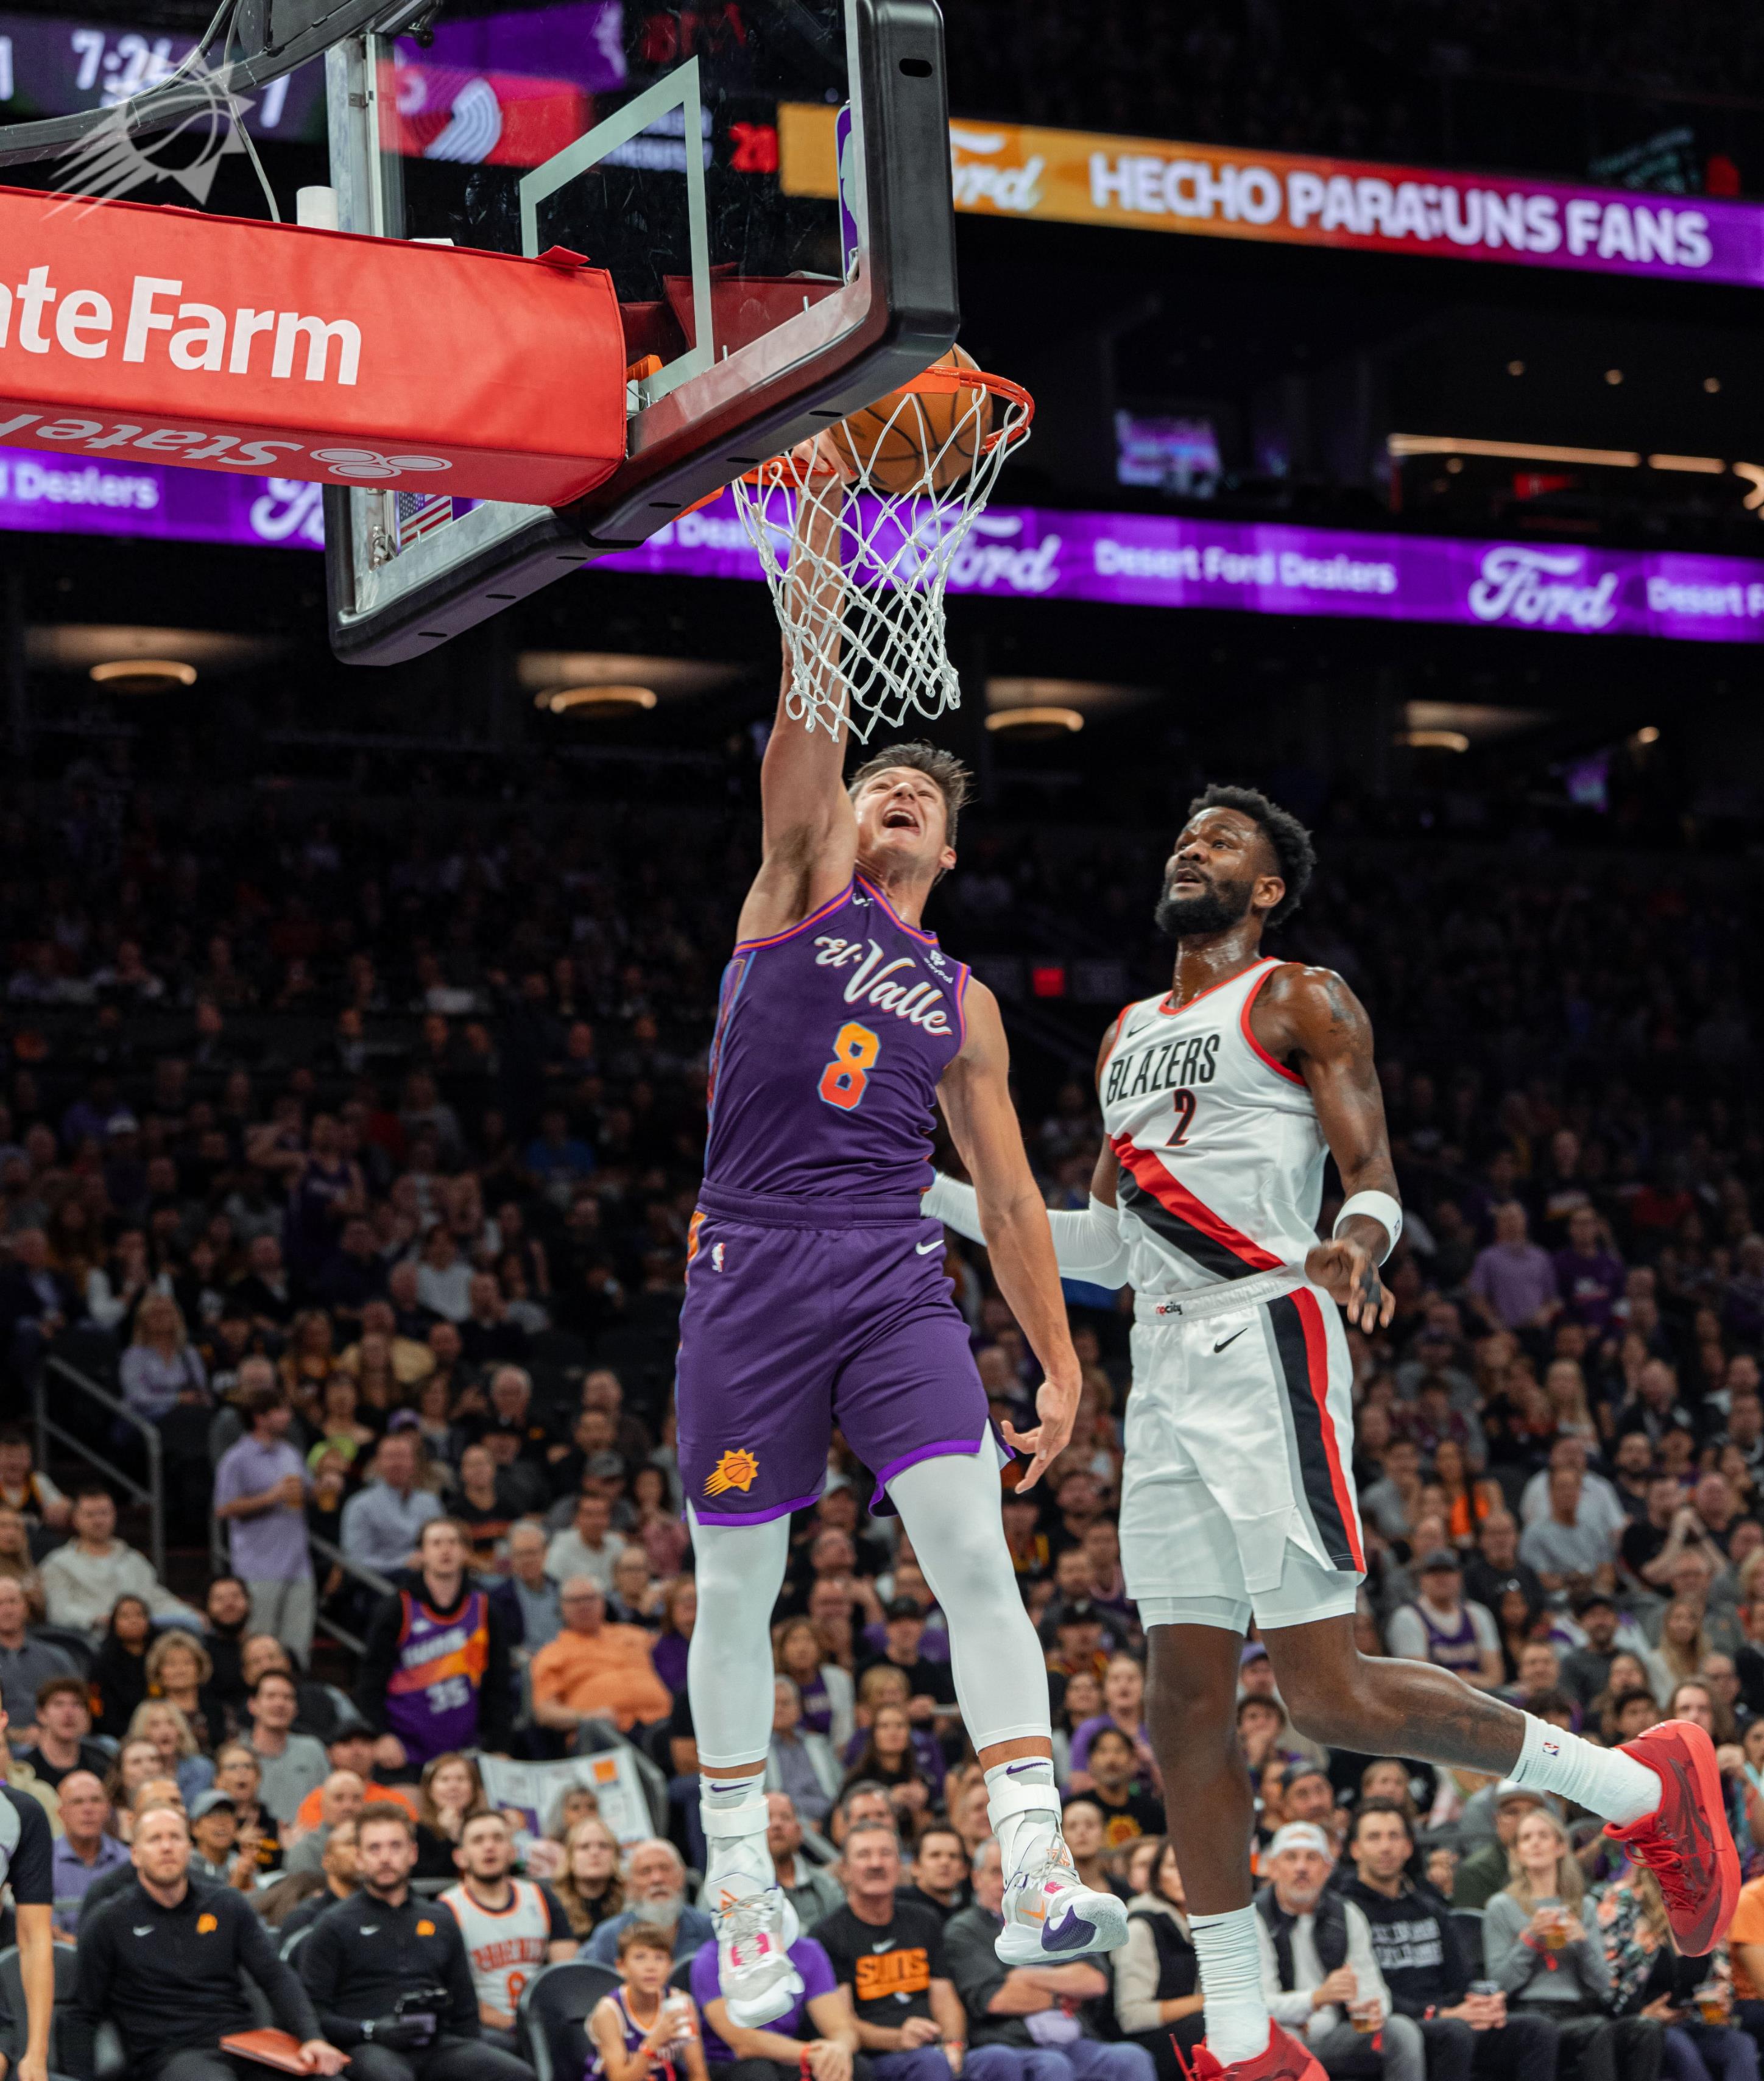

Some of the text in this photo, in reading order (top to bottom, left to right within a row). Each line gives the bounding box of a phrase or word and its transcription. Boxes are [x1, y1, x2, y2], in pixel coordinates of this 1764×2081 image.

[1089, 152, 1282, 225] HECHO
[1287, 170, 1430, 241] PARA
[1564, 197, 1714, 269] FANS
[123, 275, 362, 386] Farm
[36, 414, 305, 466] State
[15, 462, 160, 510] Dealers
[899, 507, 1062, 592] Ford
[1468, 544, 1620, 629] Ford
[844, 938, 953, 1036] Valle
[817, 1021, 881, 1111] 8
[1106, 1033, 1220, 1107] BLAZERS
[1165, 1088, 1198, 1147] 2
